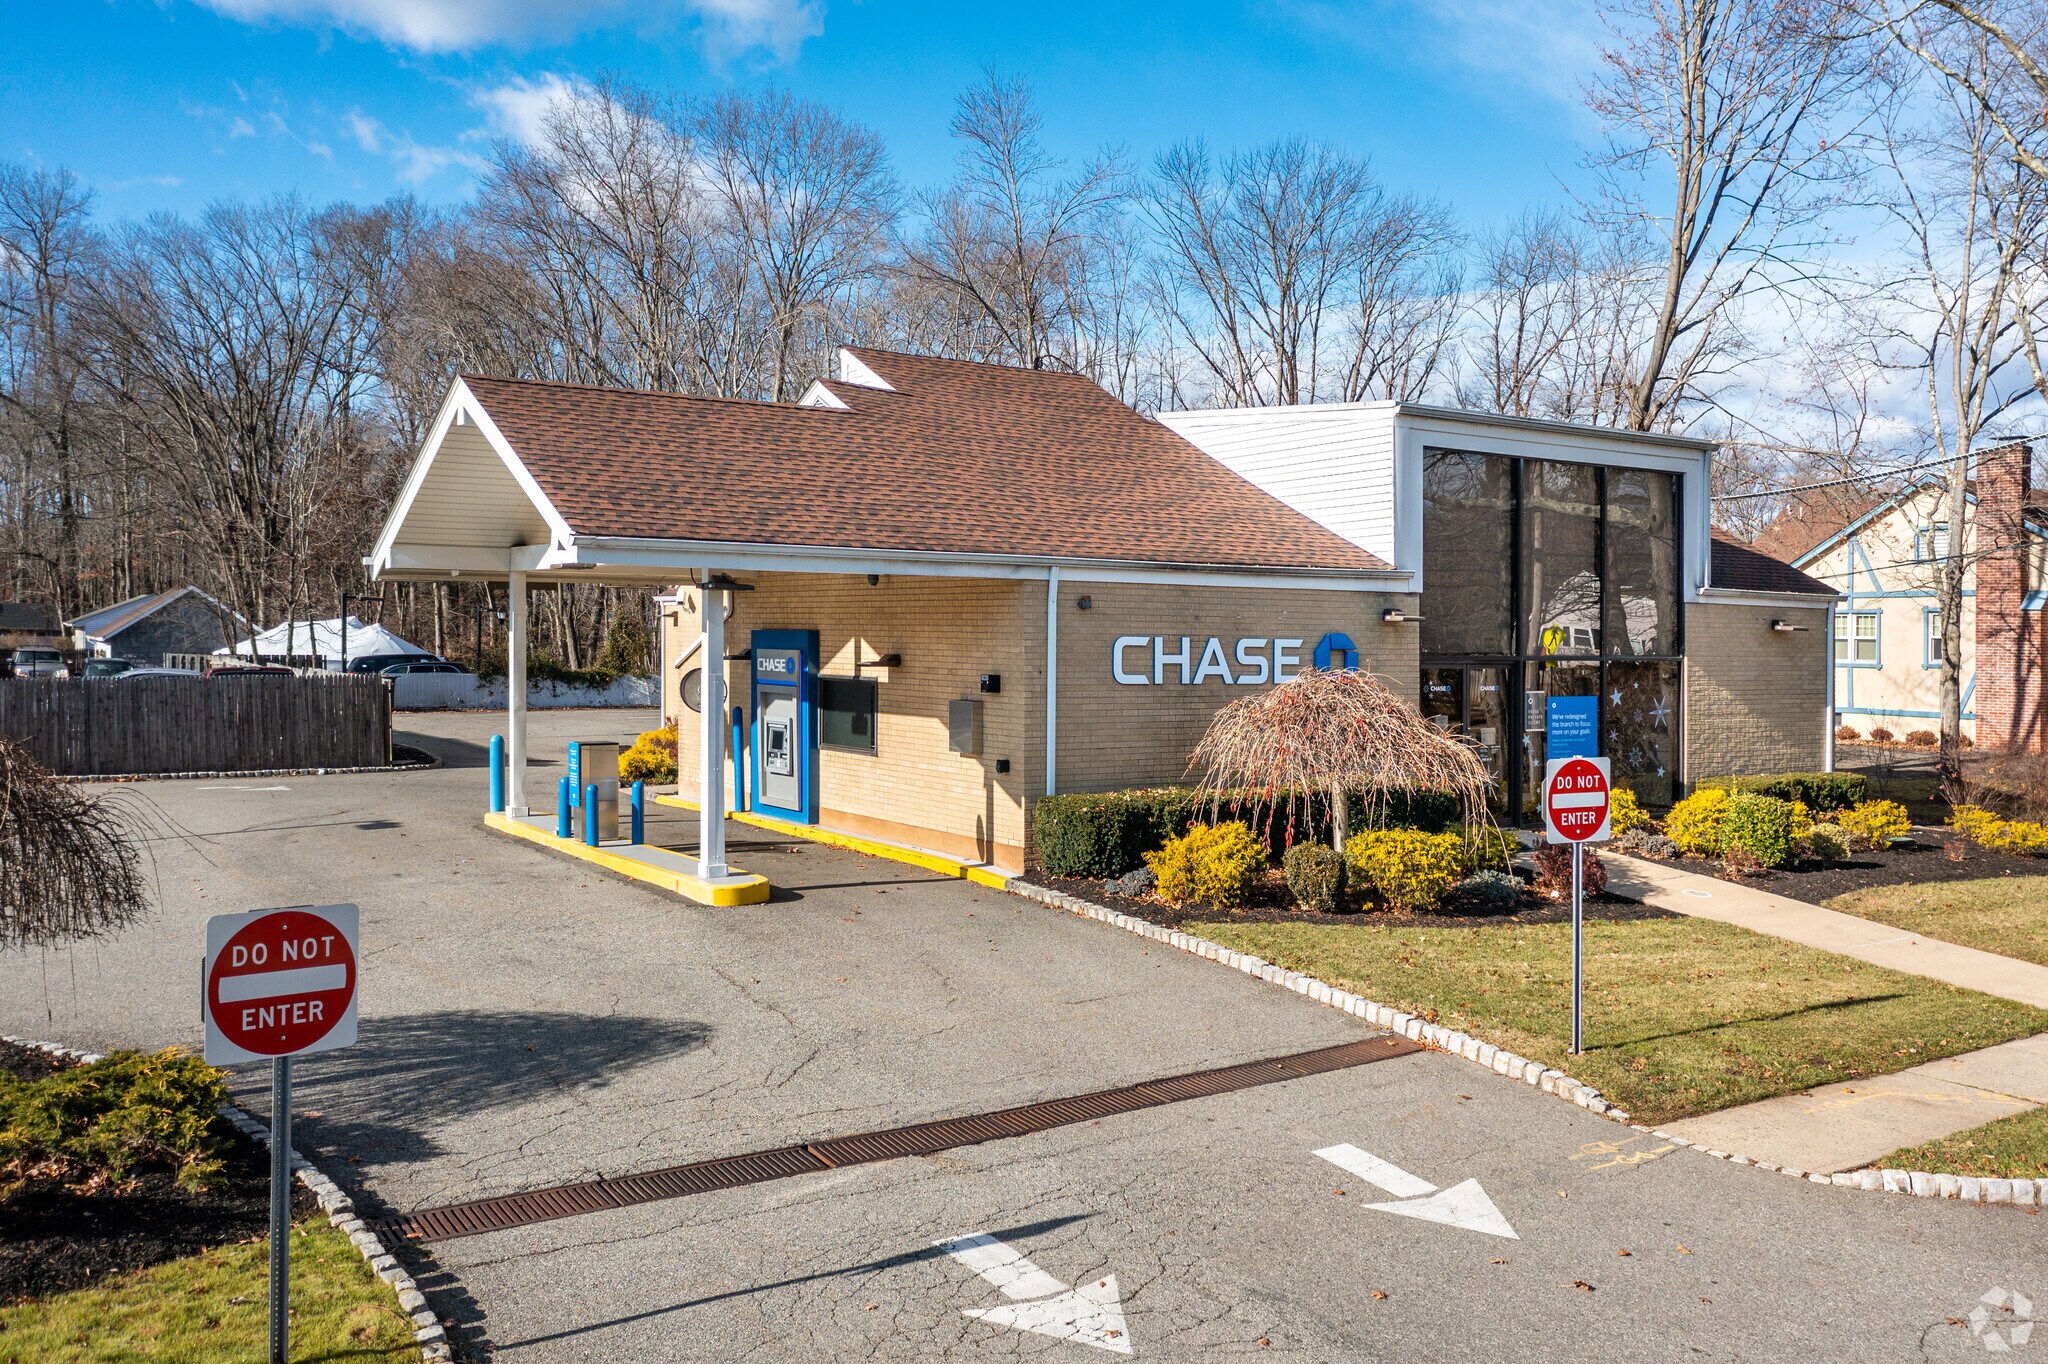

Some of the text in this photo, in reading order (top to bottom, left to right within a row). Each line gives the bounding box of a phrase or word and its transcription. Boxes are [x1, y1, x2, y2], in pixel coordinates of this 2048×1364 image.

[757, 658, 785, 671] CHASE
[1112, 636, 1303, 685] CHASE
[1557, 775, 1600, 789] DO NOT
[1561, 811, 1596, 826] ENTER
[232, 936, 335, 968] DO NOT
[242, 1000, 324, 1031] ENTER
